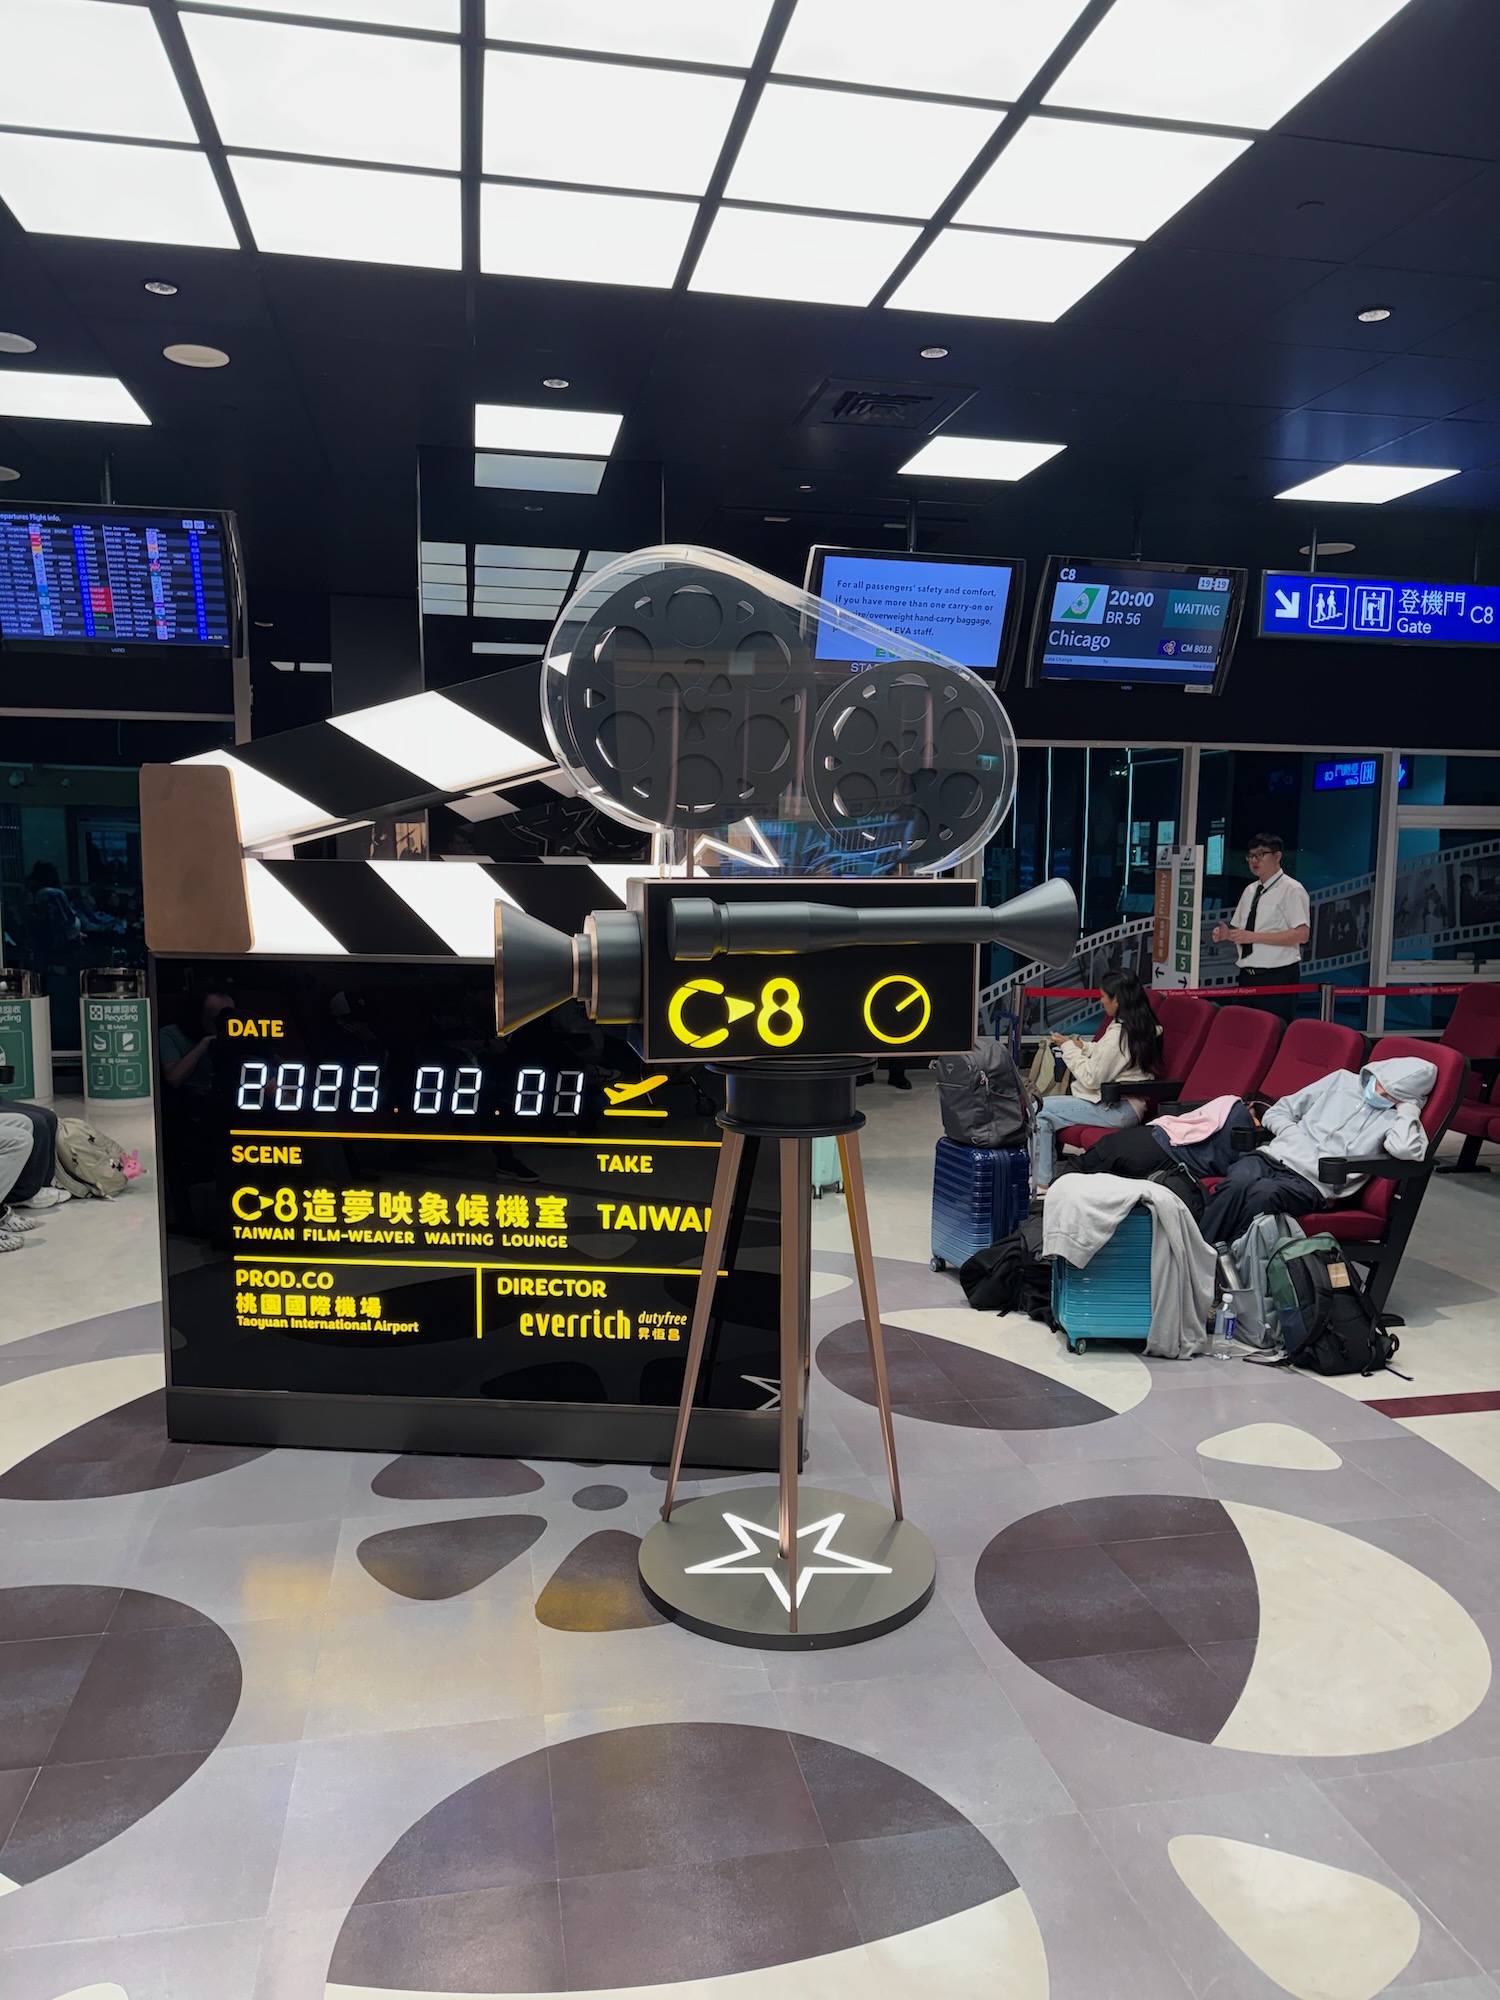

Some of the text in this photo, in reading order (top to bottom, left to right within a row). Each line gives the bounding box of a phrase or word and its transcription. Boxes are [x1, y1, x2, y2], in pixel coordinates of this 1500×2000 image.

[1059, 568, 1077, 581] C8
[837, 580, 997, 598] For all passengers' safety and comfort,
[835, 594, 842, 603] if
[843, 597, 860, 606] you
[862, 596, 882, 605] have
[909, 600, 928, 608] than
[948, 603, 982, 612] carry-on
[1109, 590, 1155, 608] 20:00
[1398, 589, 1466, 617] 登機門
[1174, 602, 1220, 616] WAITING
[1470, 606, 1494, 624] C8
[914, 615, 955, 624] hand-carry
[956, 617, 992, 626] baggage,
[1106, 611, 1141, 626] BR 56
[1397, 618, 1432, 634] Gate
[895, 626, 911, 634] EVA
[914, 628, 934, 636] staff.
[1049, 629, 1111, 651] Chicago
[1180, 644, 1213, 654] CM 8018
[1159, 873, 1167, 914] Priority
[1183, 891, 1189, 905] 2
[1182, 913, 1188, 927] 3
[1180, 935, 1187, 949] 4
[1180, 957, 1186, 970] 5
[0, 1014, 21, 1023] ycling
[104, 1014, 138, 1022] Recycling
[228, 1018, 284, 1038] DATE
[232, 1145, 302, 1164] SCENE
[597, 1154, 653, 1174] TAKE
[233, 1226, 568, 1249] TAIWAN FILM-WEAVER WAITING LOUNGE
[235, 1269, 334, 1290] PROD.CO
[497, 1277, 608, 1298] DIRECTOR
[236, 1292, 382, 1318] 桃園國際機場
[236, 1316, 419, 1335] Taoyuan International Airport
[519, 1308, 688, 1340] everrich dutyfree
